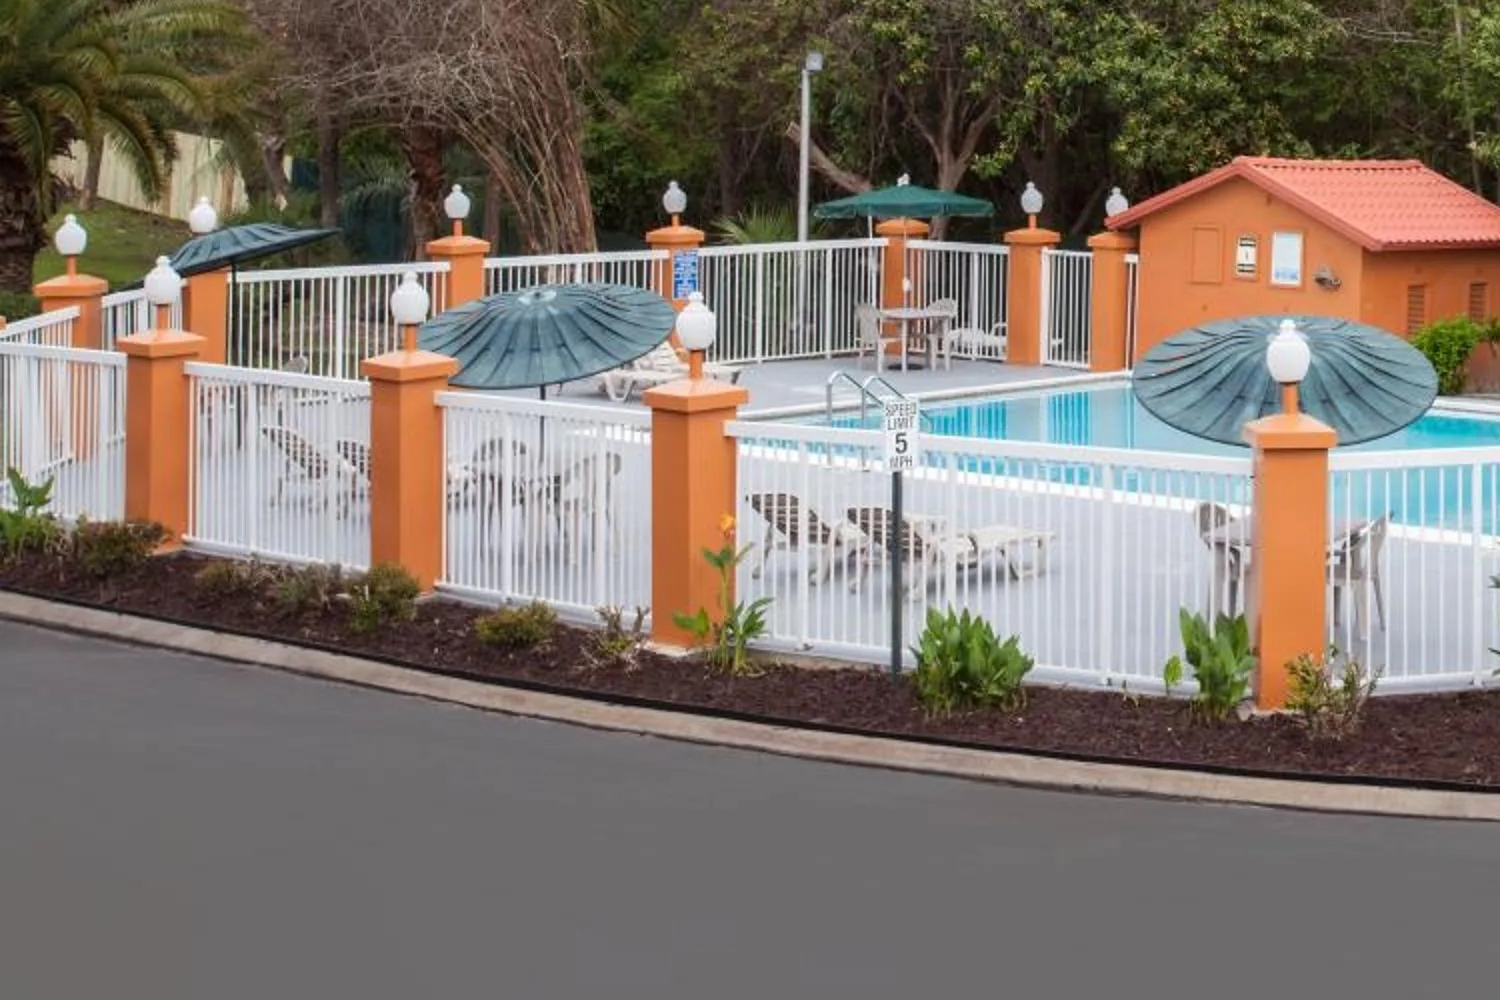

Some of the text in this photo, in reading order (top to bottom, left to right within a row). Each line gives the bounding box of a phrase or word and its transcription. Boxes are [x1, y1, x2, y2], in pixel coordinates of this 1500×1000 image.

[885, 402, 917, 416] SPEED
[887, 416, 914, 430] LIMIT
[895, 432, 908, 454] 5
[889, 455, 913, 468] MPH
